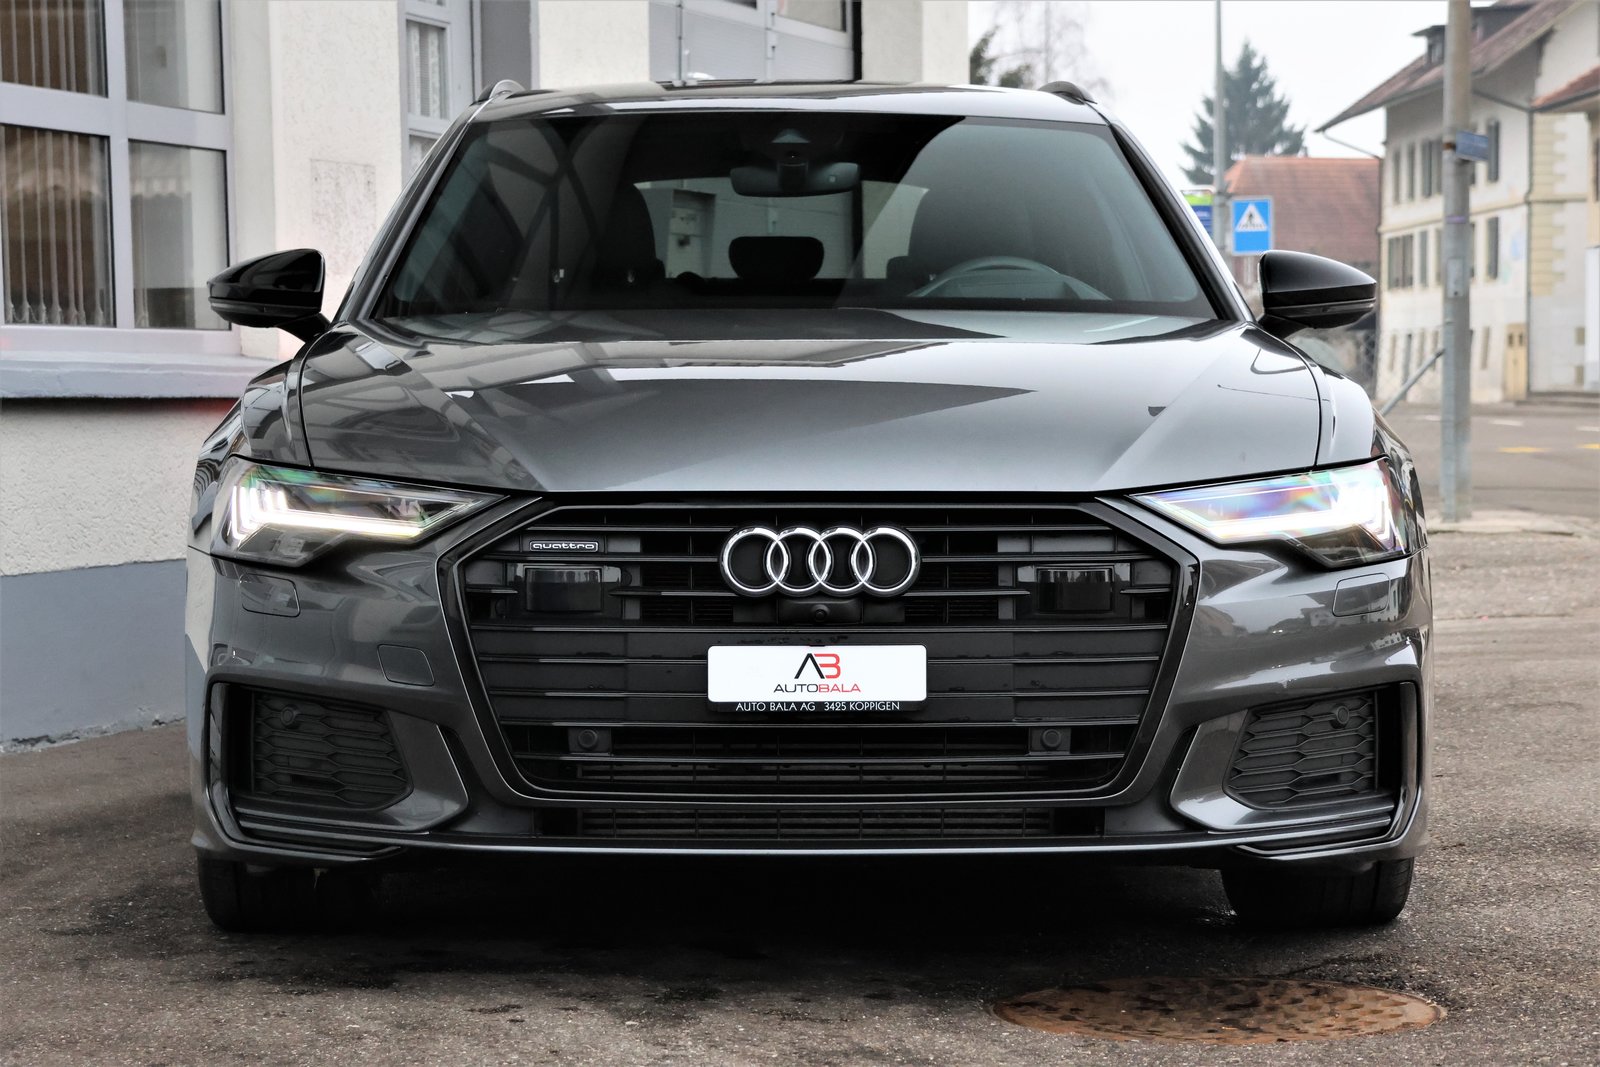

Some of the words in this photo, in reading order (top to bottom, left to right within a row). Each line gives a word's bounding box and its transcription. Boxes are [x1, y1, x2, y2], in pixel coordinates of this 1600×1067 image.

[532, 542, 595, 550] quattro
[773, 683, 861, 693] AUTOBALA
[735, 701, 766, 711] AUTO
[769, 701, 797, 711] BALA
[799, 701, 816, 711] AG
[823, 701, 847, 711] 3425
[849, 701, 900, 711] KOPPIGEN
